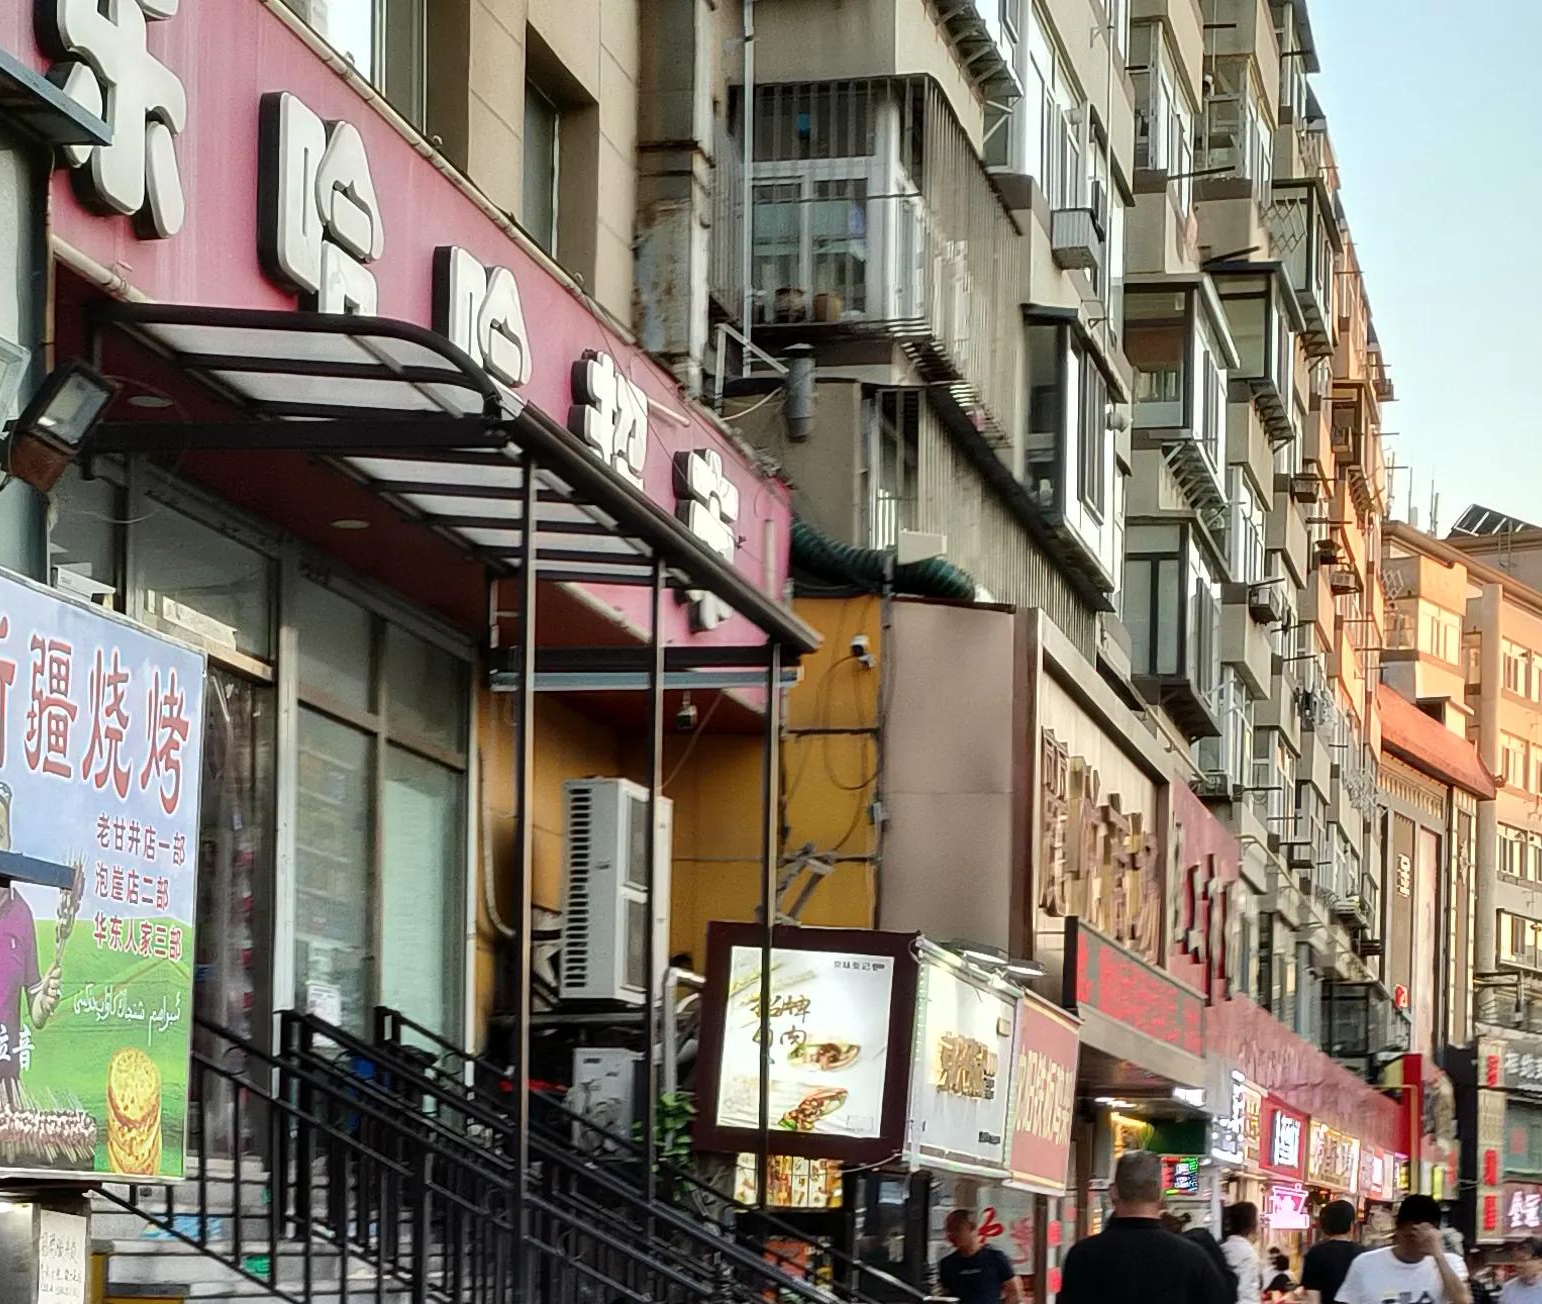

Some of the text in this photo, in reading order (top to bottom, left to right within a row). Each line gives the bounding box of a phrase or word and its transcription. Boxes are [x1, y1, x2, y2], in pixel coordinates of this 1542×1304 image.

[96, 812, 186, 866] 老甘井店一部
[95, 862, 170, 911] 泡崖店二部
[94, 911, 182, 961] 华东人家三部
